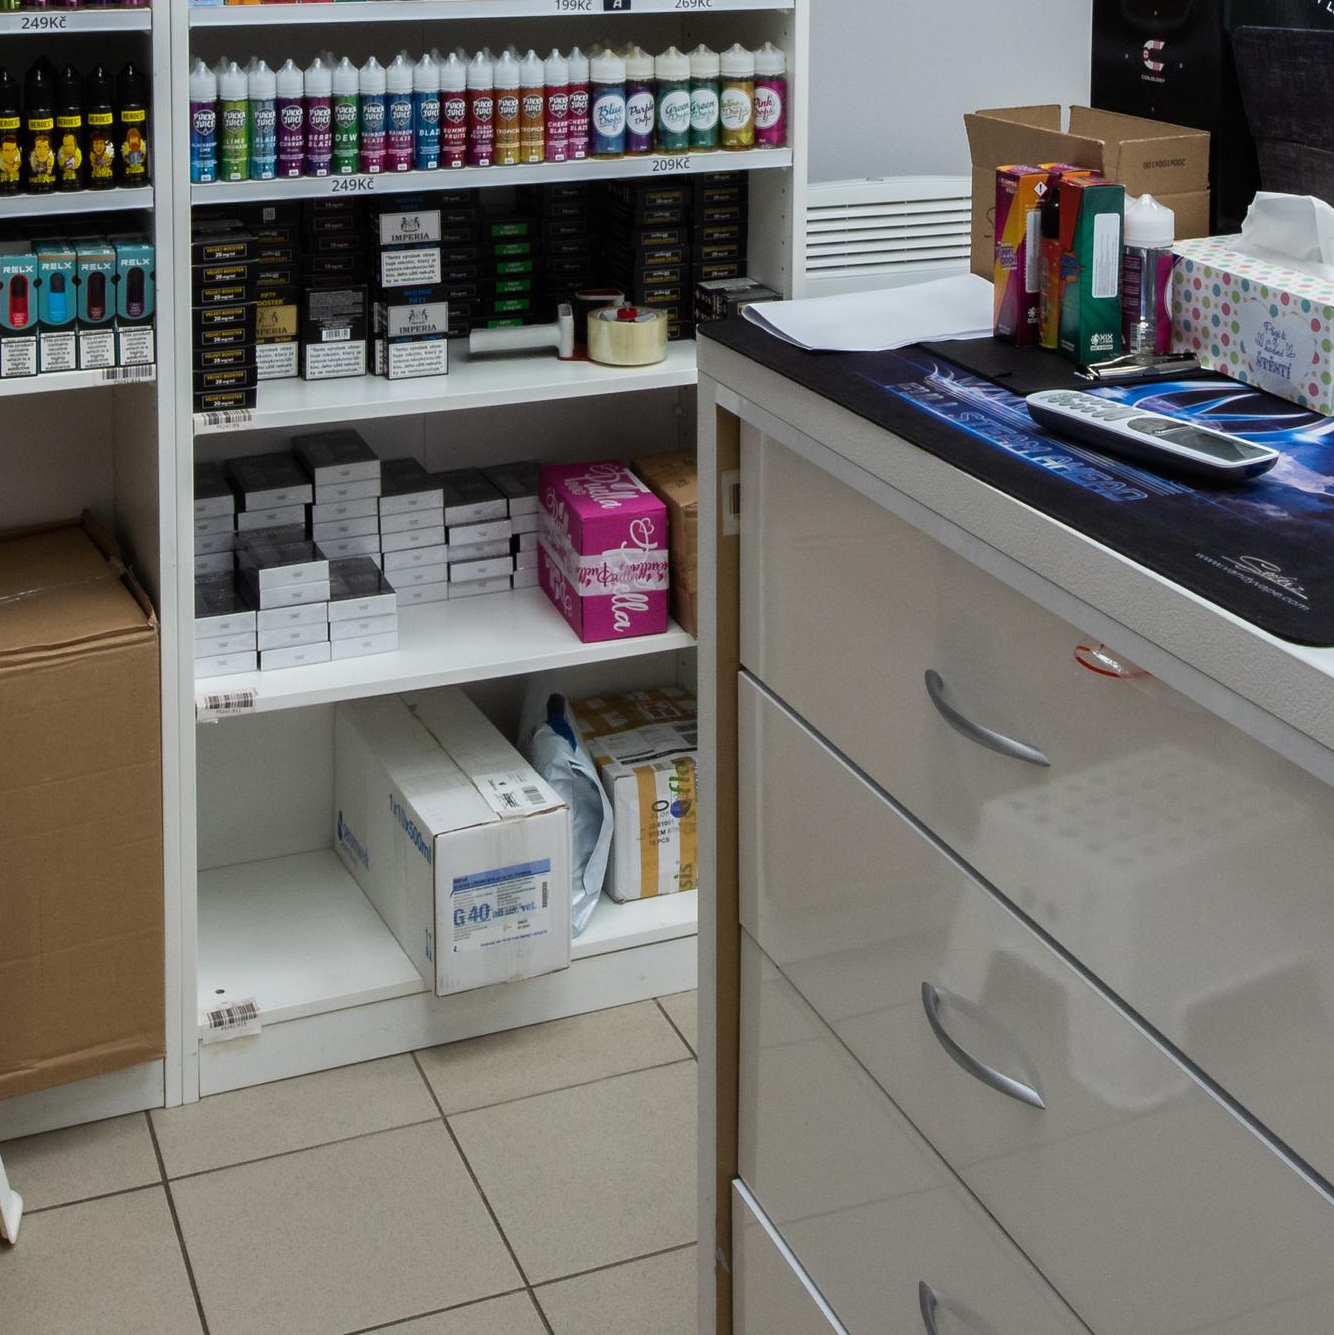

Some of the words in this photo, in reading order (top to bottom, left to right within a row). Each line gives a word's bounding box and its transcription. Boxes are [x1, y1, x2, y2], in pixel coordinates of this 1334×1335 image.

[21, 16, 67, 30] 249Kč
[335, 133, 357, 142] DEW
[652, 158, 691, 172] 209Kč
[332, 178, 374, 193] 249Kč
[391, 232, 430, 242] IMPERIA
[42, 262, 71, 270] RELX
[81, 262, 110, 271] RELX
[121, 258, 150, 266] RELX
[3, 265, 33, 273] RELX
[399, 324, 437, 334] IMPERIA
